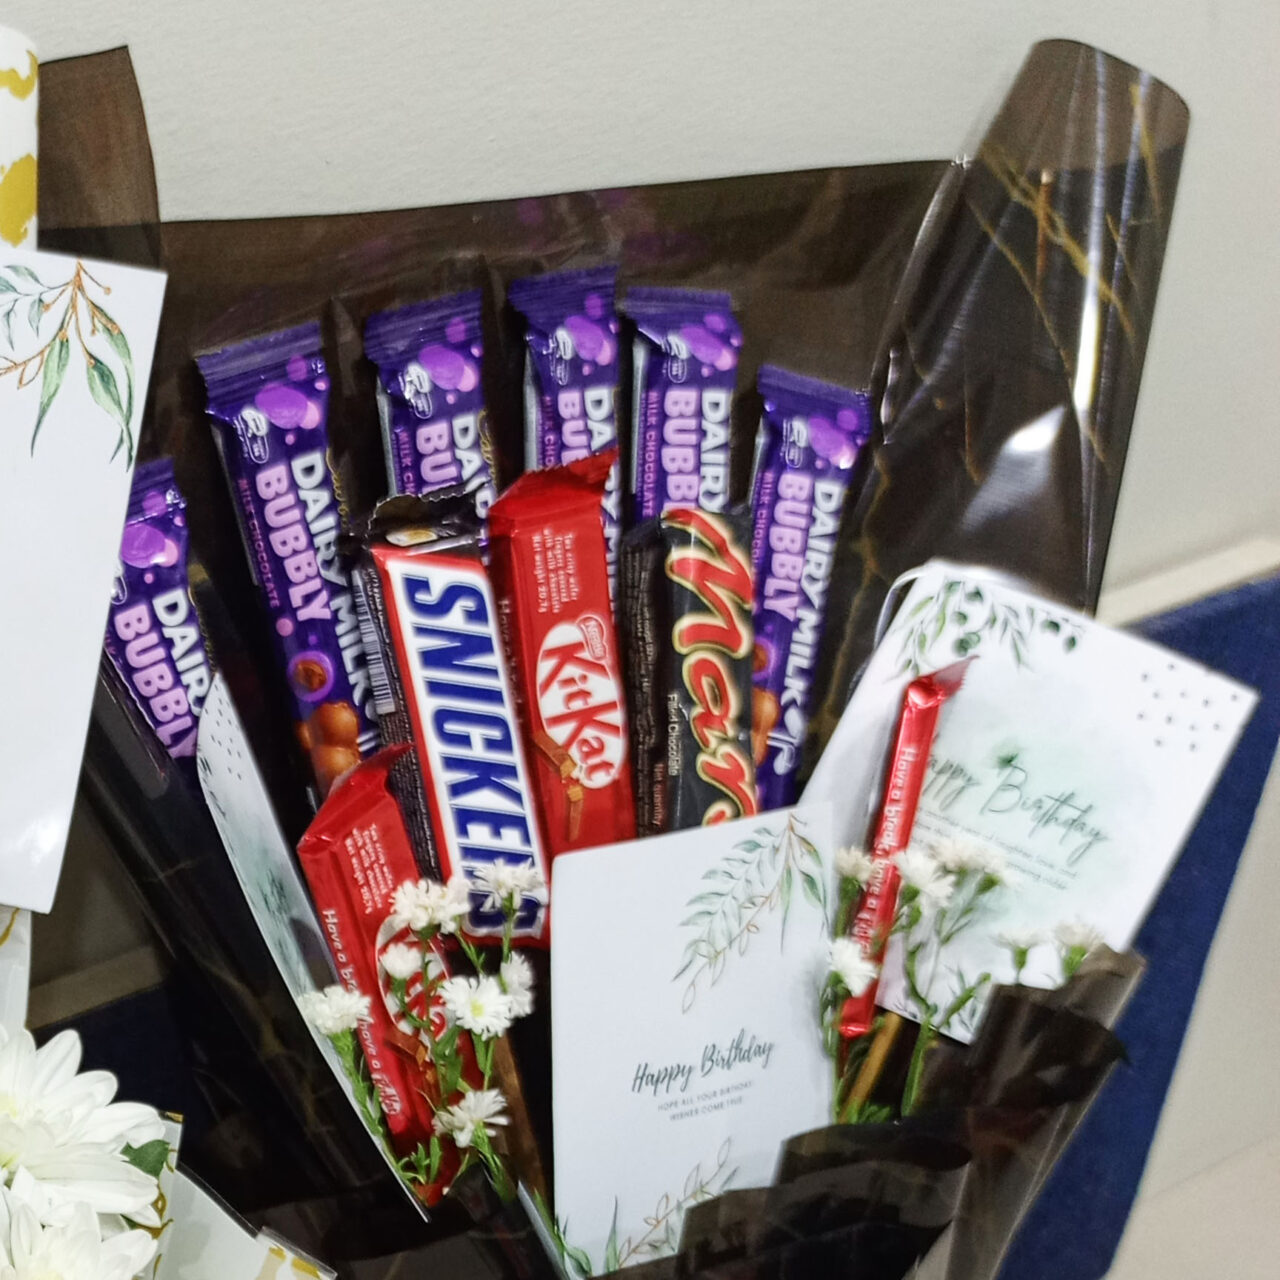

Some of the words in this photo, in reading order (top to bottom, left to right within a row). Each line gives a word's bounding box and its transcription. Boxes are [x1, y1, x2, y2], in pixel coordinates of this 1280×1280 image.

[642, 431, 657, 517] CHOCOLATE
[661, 389, 699, 510] BUBB
[248, 520, 280, 608] CHOCOLATE
[255, 465, 331, 622] BUBBLY
[291, 451, 348, 587] DAIRY
[329, 593, 370, 706] MILK
[764, 472, 813, 622] BUBBLY
[800, 480, 844, 609] DAIRY
[114, 604, 198, 758] BUBBLY
[539, 642, 621, 782] KitKat
[661, 508, 757, 826] Mar
[780, 608, 818, 707] MILK
[668, 724, 680, 776] Chocolate
[891, 790, 901, 801] a
[894, 748, 916, 789] Have
[923, 757, 982, 812] appy
[979, 763, 1110, 868] Birthday
[322, 908, 345, 950] Have
[336, 952, 347, 963] a
[357, 1013, 377, 1057] have
[371, 1058, 381, 1069] a
[631, 1062, 696, 1096] Happy
[700, 1028, 775, 1078] Birthday
